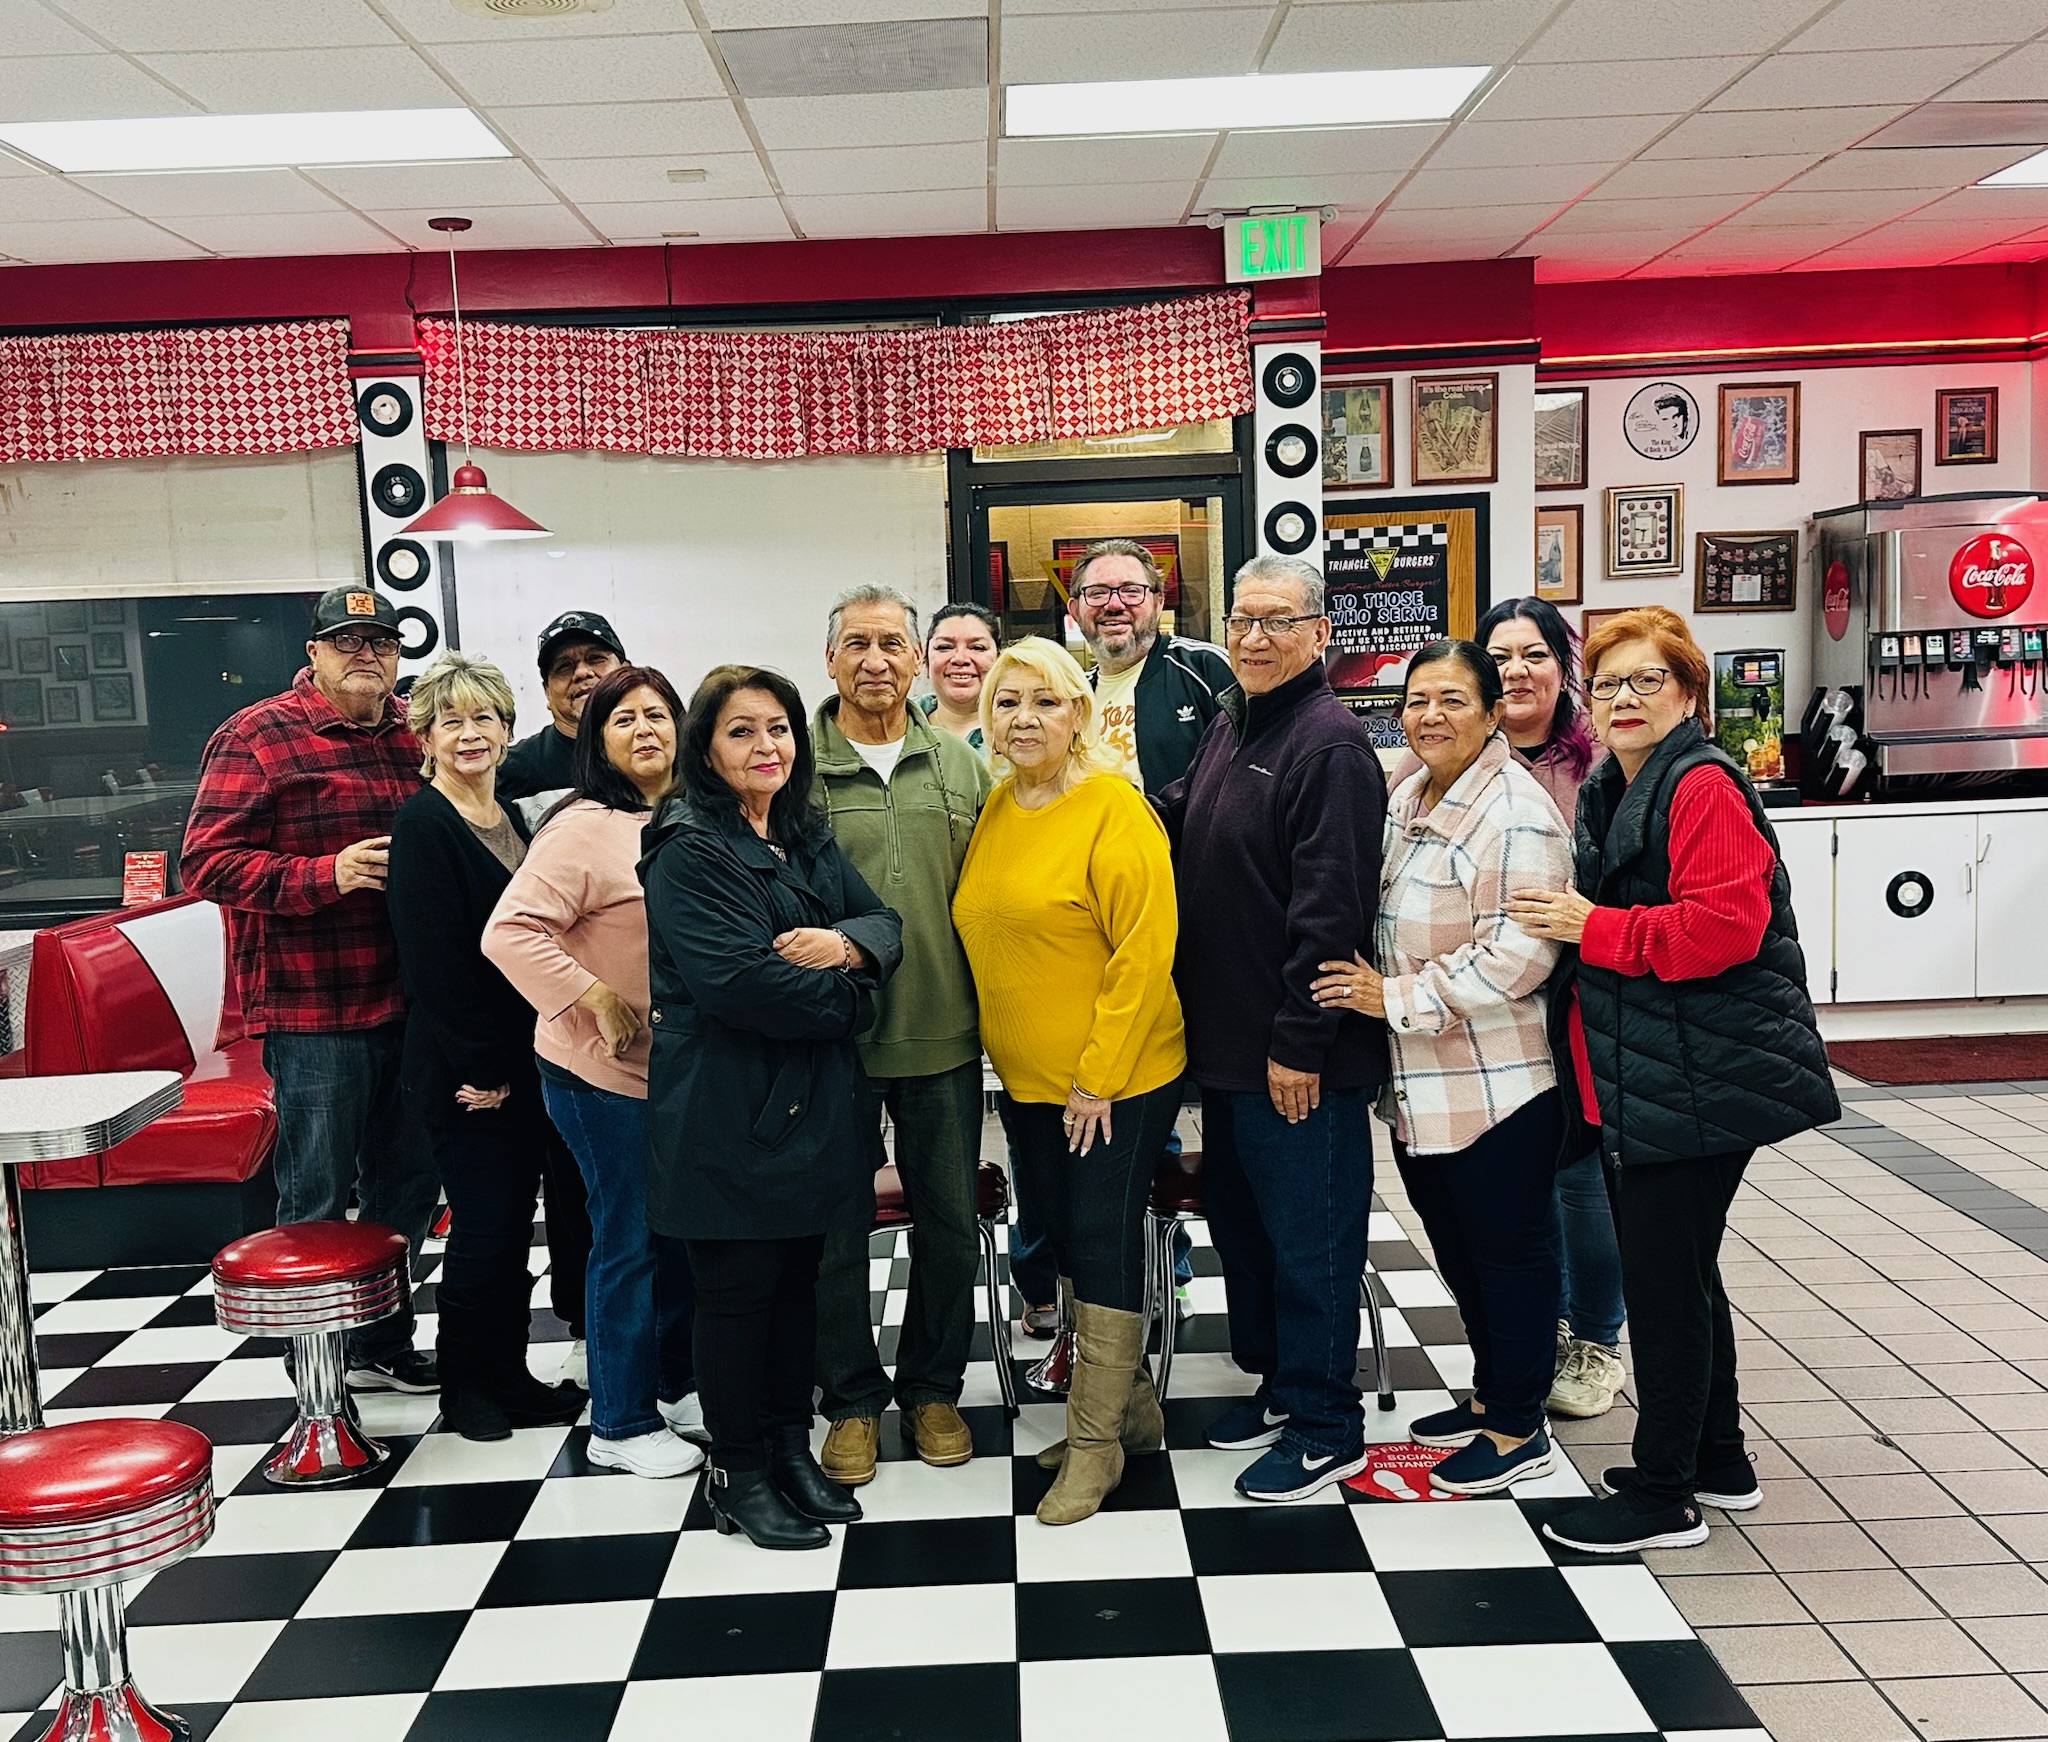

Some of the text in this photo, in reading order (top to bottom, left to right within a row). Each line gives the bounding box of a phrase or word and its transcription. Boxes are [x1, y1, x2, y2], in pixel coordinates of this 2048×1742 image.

[1241, 216, 1307, 275] EXIT
[1328, 555, 1435, 571] TRIANGLE BURGERS
[1962, 563, 2028, 588] Coca-Cola
[1333, 591, 1424, 610] TO THOSE
[1328, 605, 1438, 625] WHO SERVE
[1336, 625, 1431, 637] ACTIVE AND RETIRED
[1358, 636, 1371, 645] US
[1374, 636, 1385, 644] TO
[1388, 633, 1421, 643] SALUTE
[1424, 632, 1443, 641] YOU
[1343, 641, 1425, 654] WITH A DISCOUNT
[1363, 720, 1386, 733] 0%
[1372, 734, 1409, 748] PURC
[1380, 1445, 1409, 1454] FOR
[1413, 1445, 1458, 1455] PRAC
[1387, 1453, 1436, 1461] SOCIAL
[1373, 1460, 1440, 1469] DISTANCI
